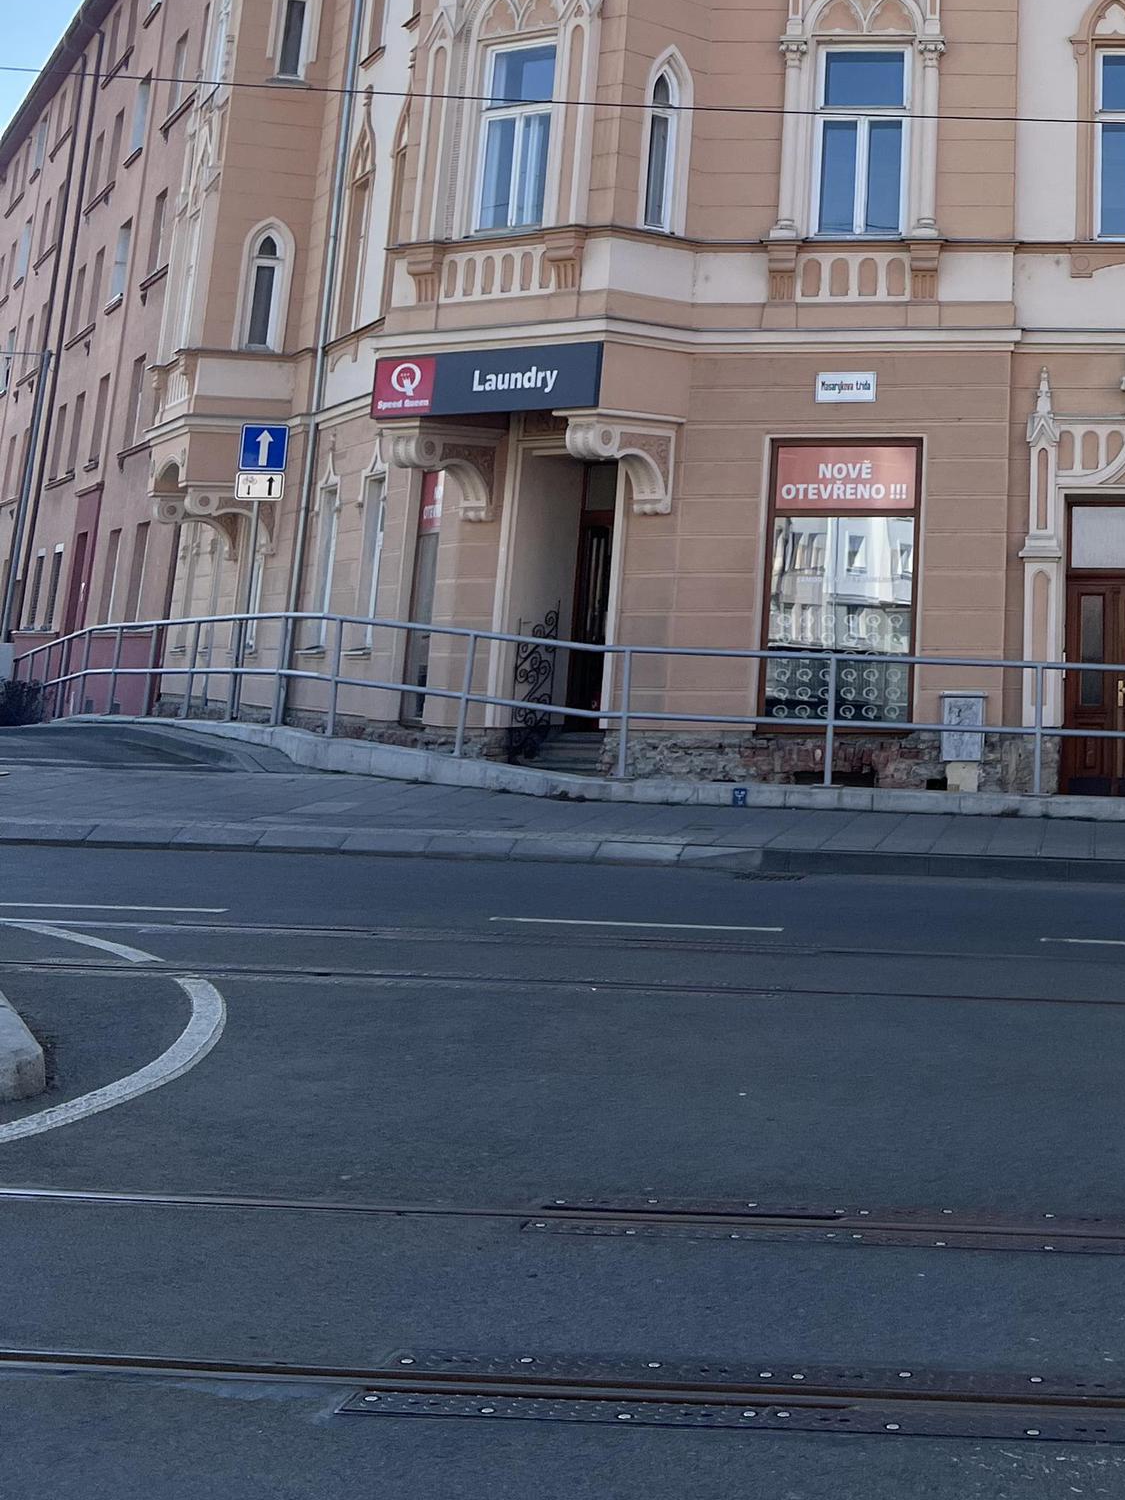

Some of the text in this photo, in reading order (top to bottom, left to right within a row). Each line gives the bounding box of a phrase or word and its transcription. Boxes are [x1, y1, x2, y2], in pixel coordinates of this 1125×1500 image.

[472, 366, 558, 393] Laundry
[377, 398, 429, 411] Speed Queen
[818, 460, 872, 479] NOVĚ
[781, 481, 885, 499] OTEVŘENO
